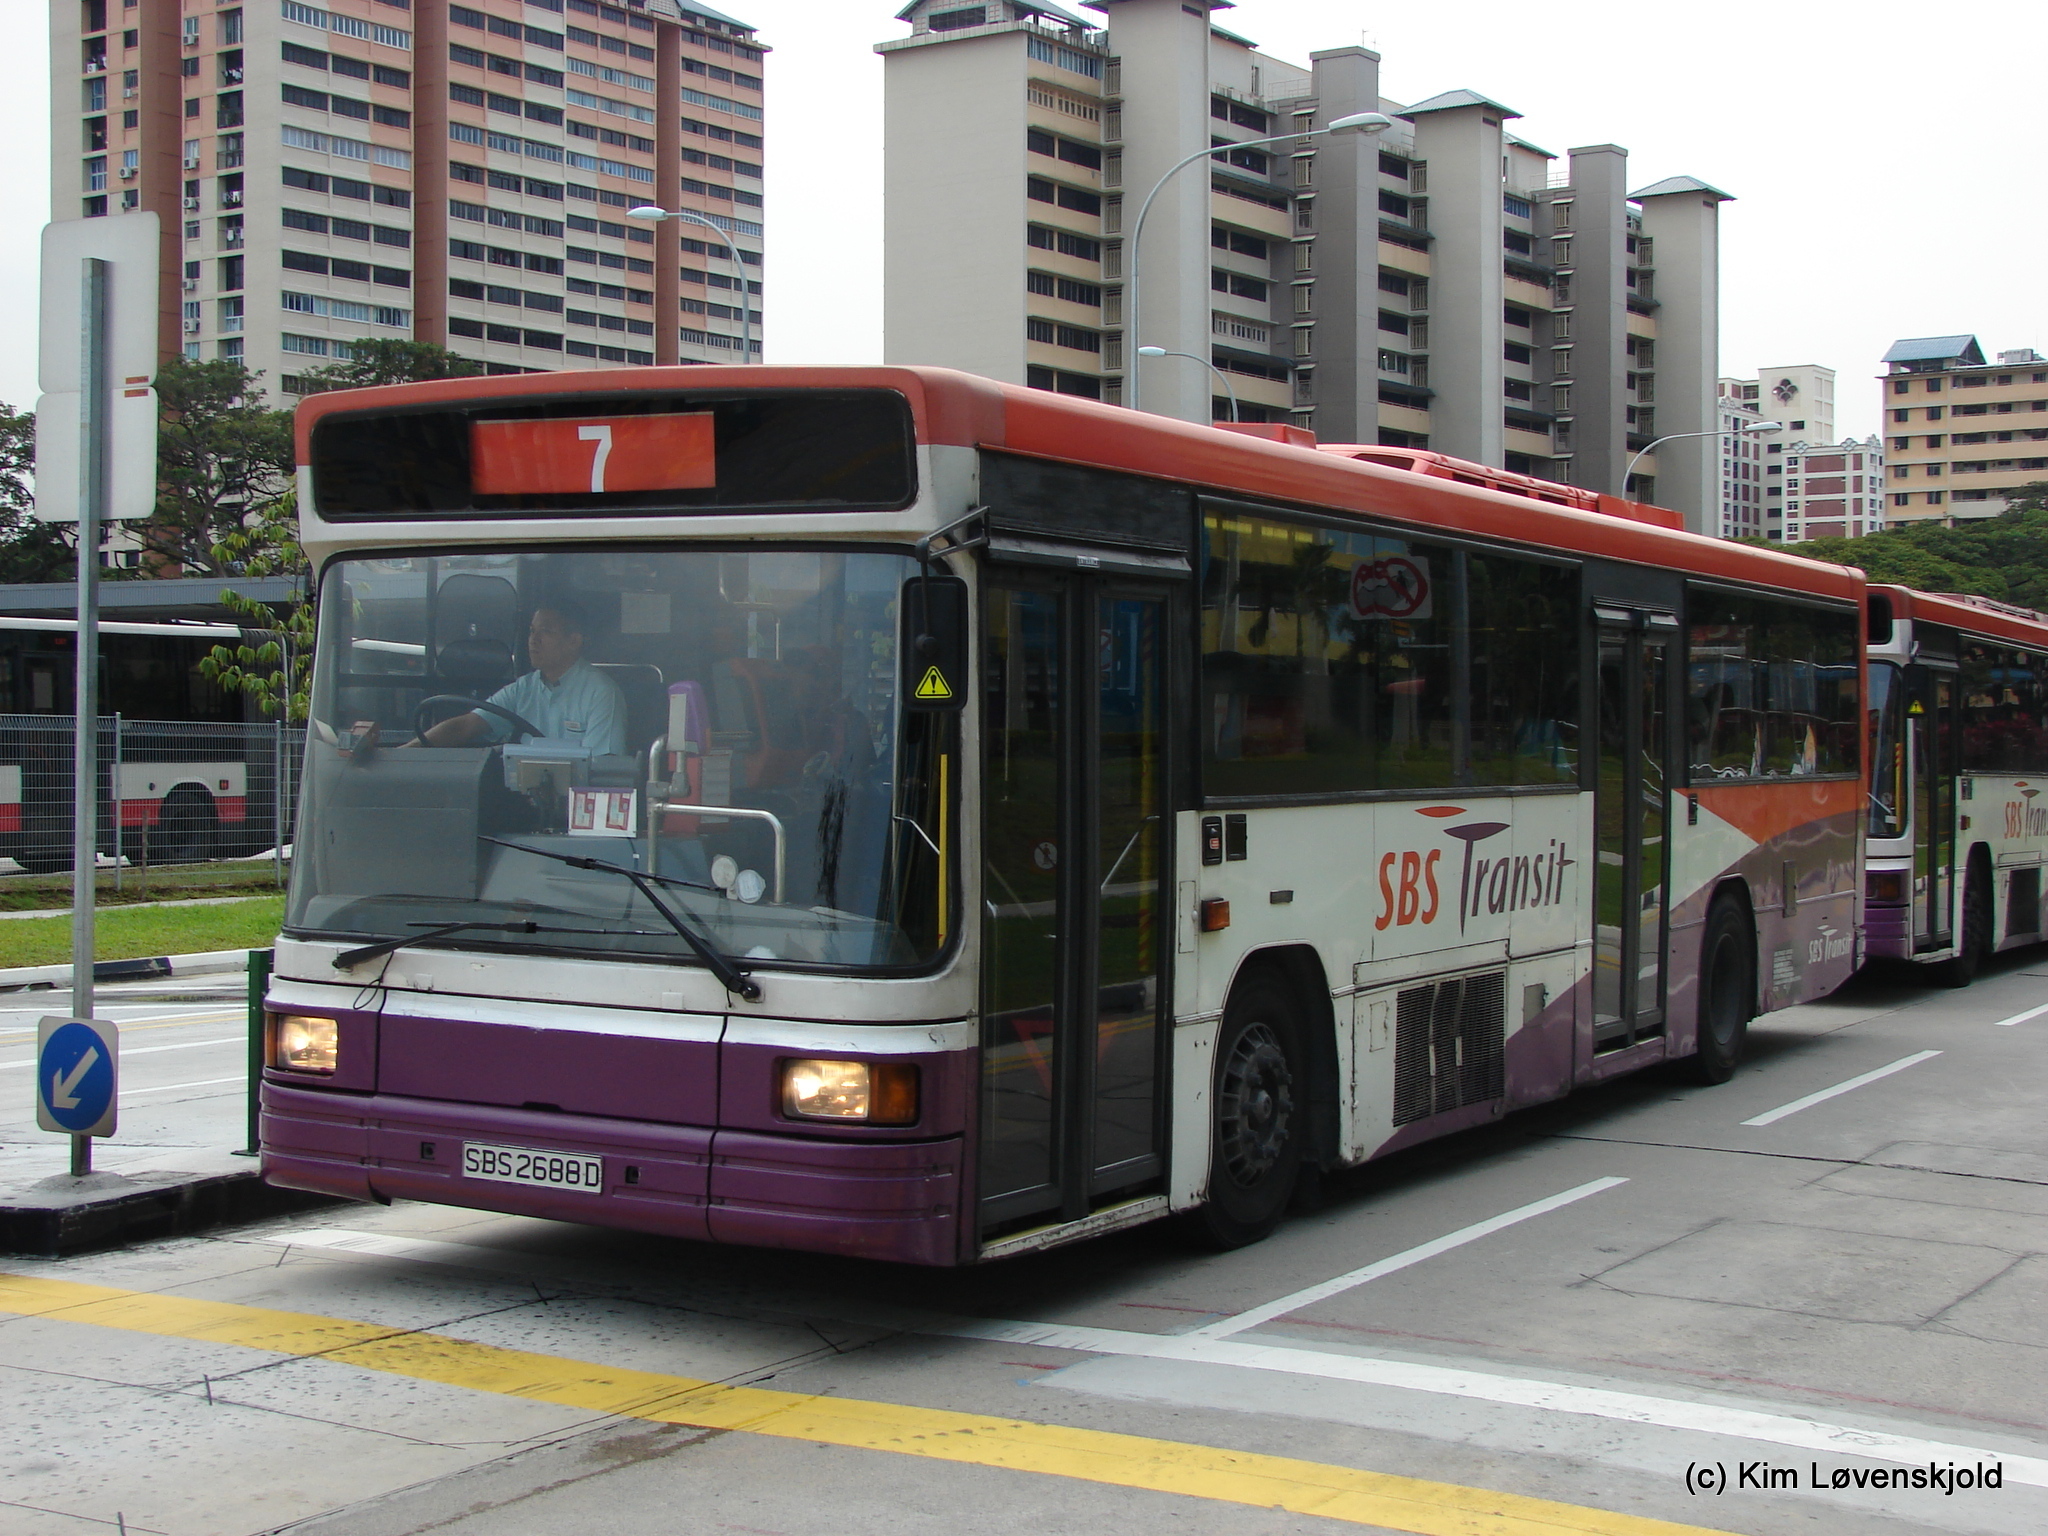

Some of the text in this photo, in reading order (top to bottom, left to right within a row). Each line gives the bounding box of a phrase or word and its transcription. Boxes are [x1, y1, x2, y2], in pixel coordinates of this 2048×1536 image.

[577, 425, 613, 493] 7
[2004, 789, 2048, 844] SBS Tran
[1375, 822, 1576, 938] SBS Transit
[1808, 938, 1824, 965] SBS
[465, 1148, 600, 1187] SBS2688D
